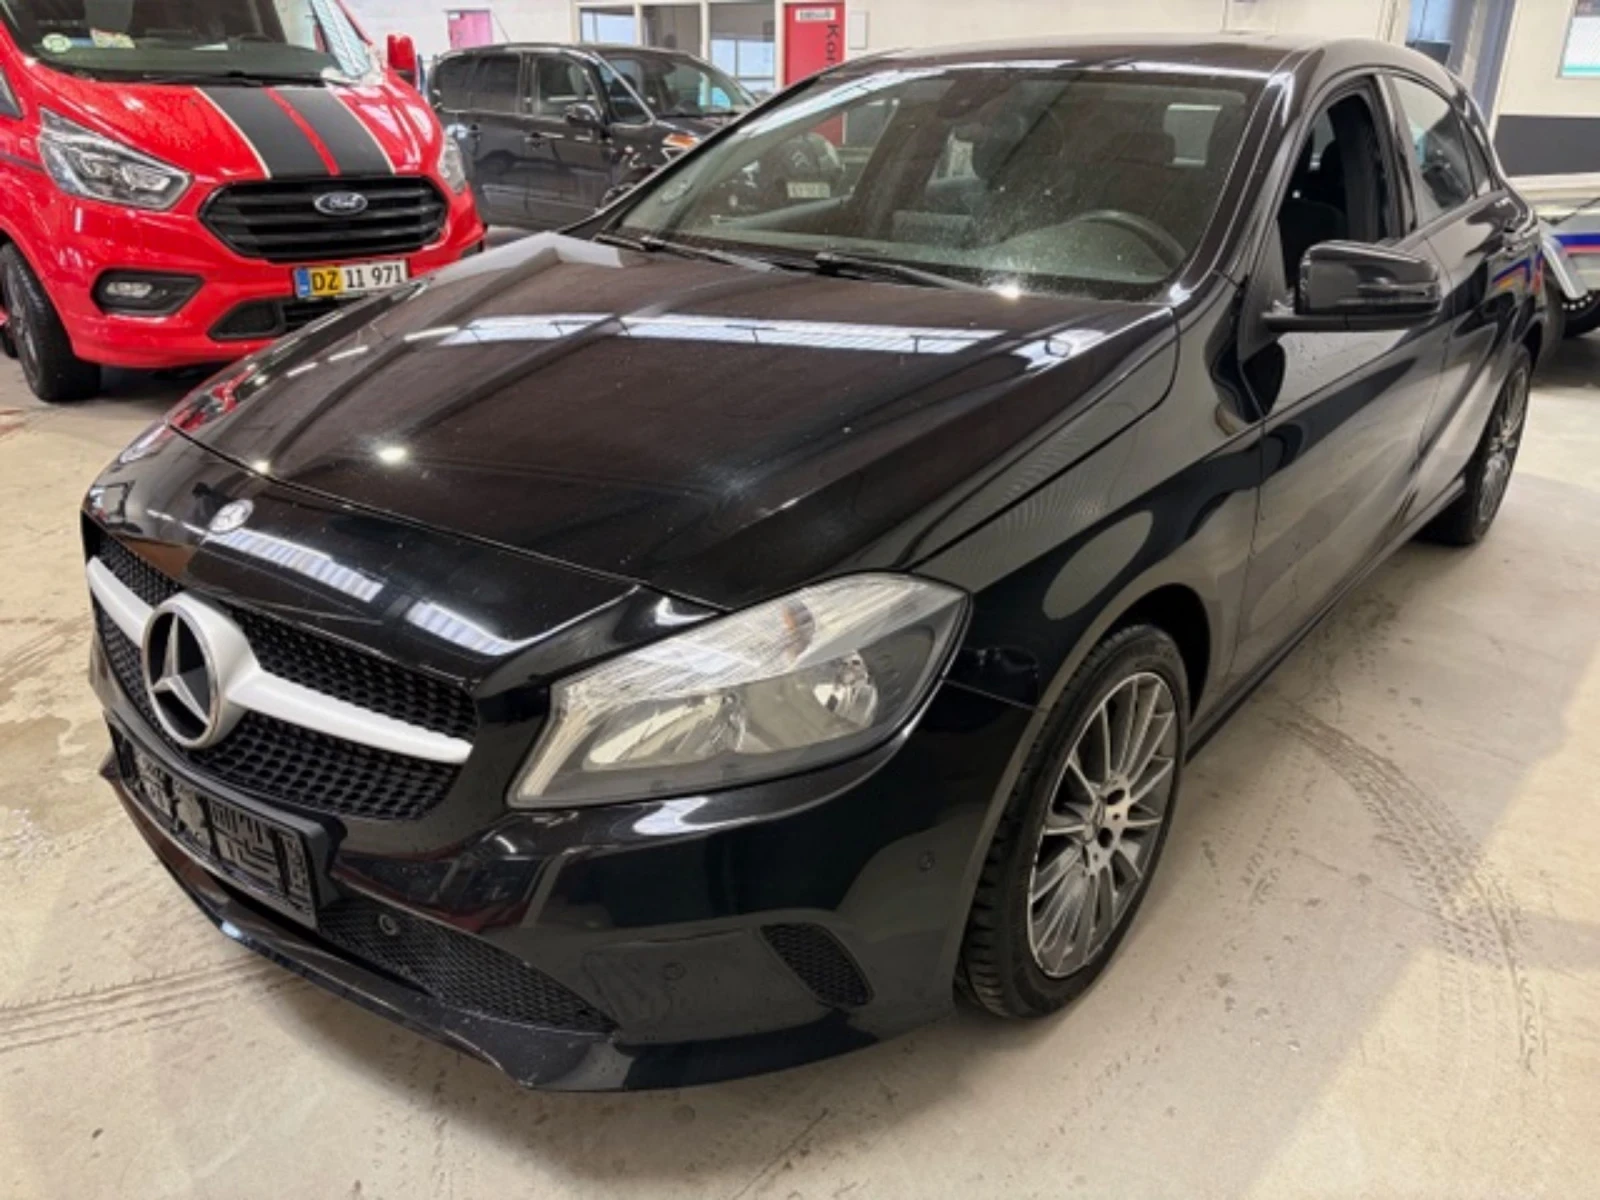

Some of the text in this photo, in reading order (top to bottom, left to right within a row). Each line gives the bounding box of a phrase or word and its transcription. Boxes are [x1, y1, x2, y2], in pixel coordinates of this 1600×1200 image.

[311, 264, 402, 292] DZ 11 971
